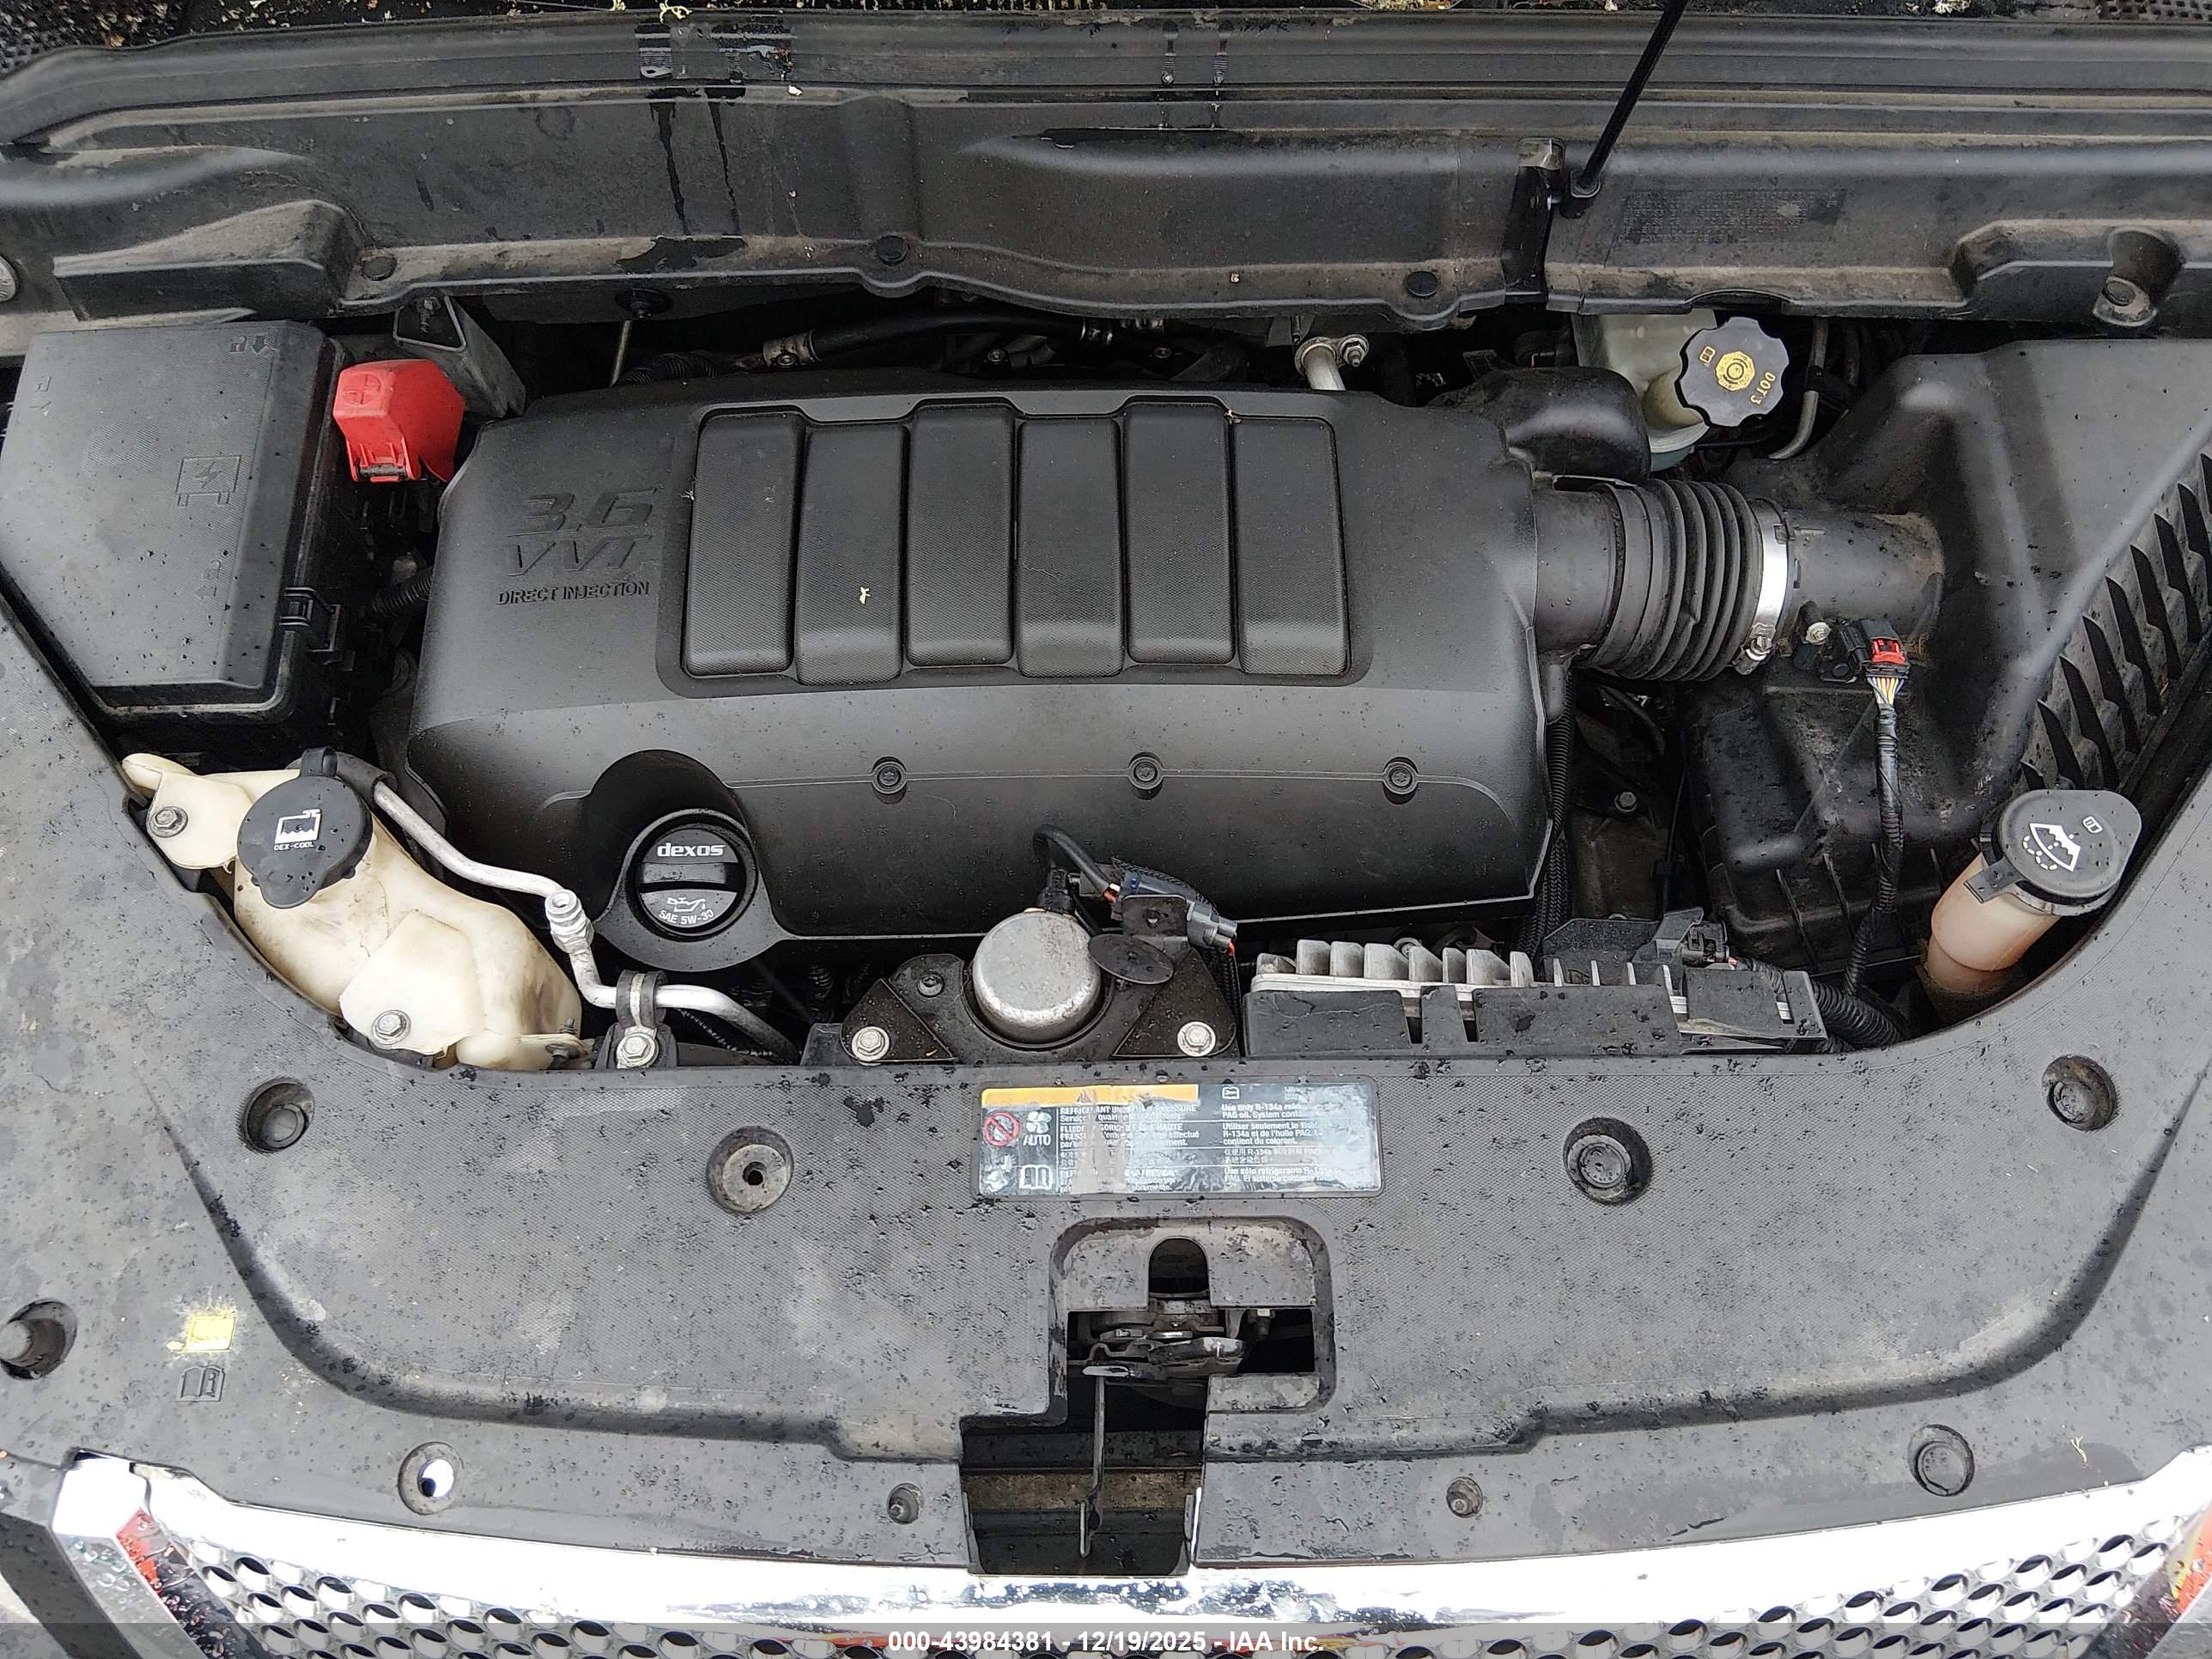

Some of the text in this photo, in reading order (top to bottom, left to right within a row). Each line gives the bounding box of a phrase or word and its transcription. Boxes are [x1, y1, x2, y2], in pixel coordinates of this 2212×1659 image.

[1750, 371, 1777, 404] DOT 3
[505, 488, 658, 538] 3.6
[505, 537, 653, 578] VVT
[496, 580, 650, 605] DIRECT INJECTION
[273, 842, 315, 851] DEX-COOL
[657, 842, 726, 857] dexos
[659, 908, 714, 925] SAE 5W-30
[1253, 1111, 1280, 1120] System
[1023, 1133, 1052, 1146] AUTO
